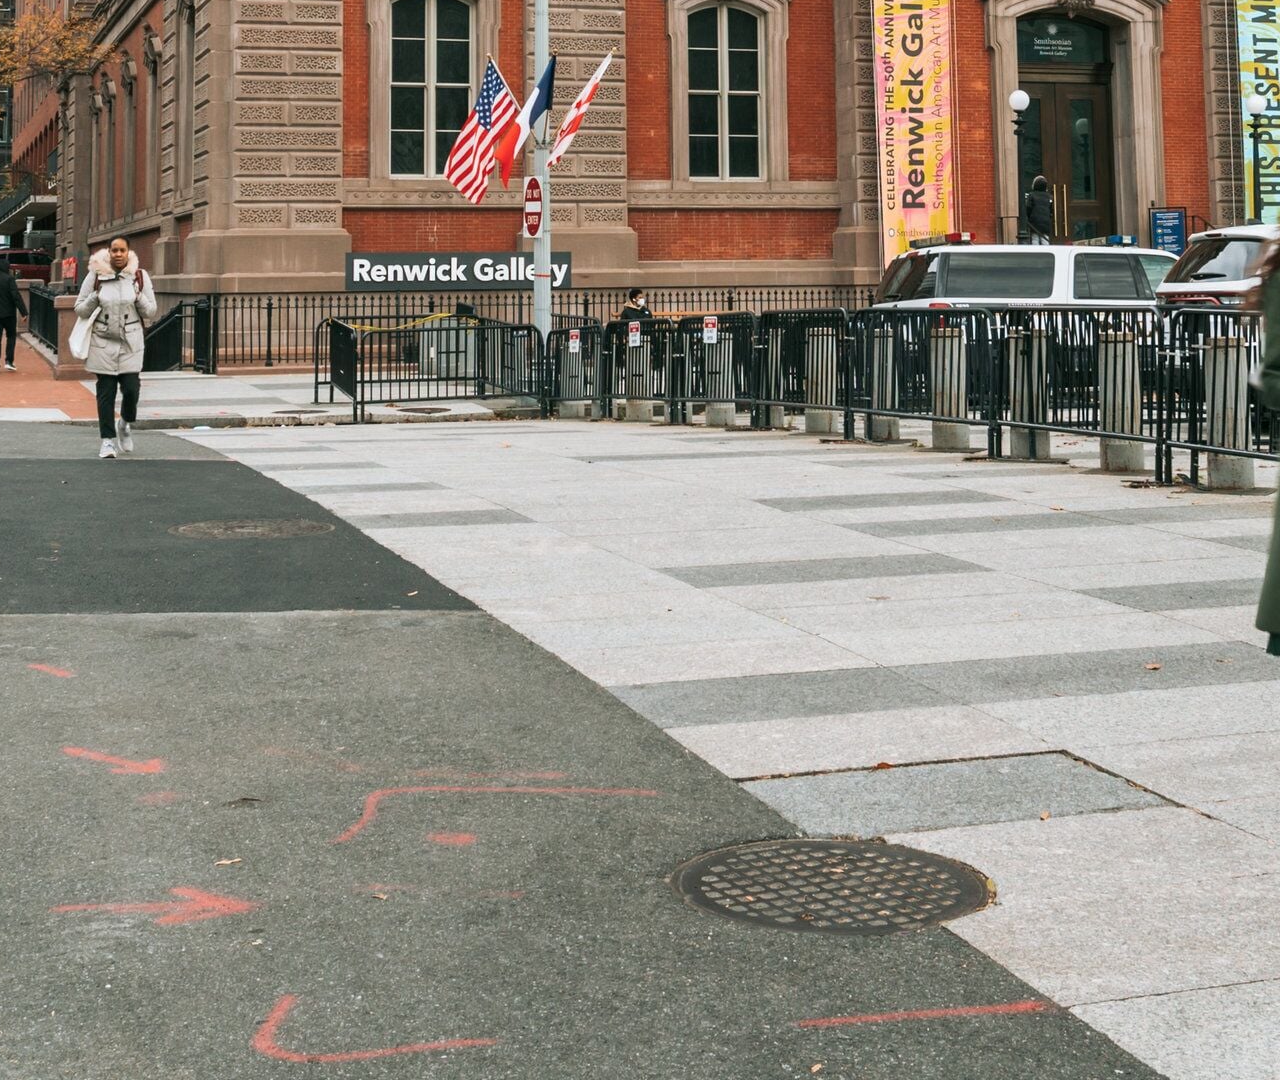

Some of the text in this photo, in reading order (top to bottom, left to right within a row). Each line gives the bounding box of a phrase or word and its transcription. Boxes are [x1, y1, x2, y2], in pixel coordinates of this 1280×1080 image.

[929, 25, 941, 45] Art
[881, 51, 895, 82] 50th
[884, 86, 895, 112] THE
[929, 50, 943, 118] American
[900, 67, 926, 209] Renwick
[884, 116, 896, 211] CELEBRATING
[932, 121, 945, 209] Smithsonian
[527, 215, 539, 225] ENTER
[896, 227, 947, 238] Smithsonian
[352, 256, 568, 287] Renwick Galley
